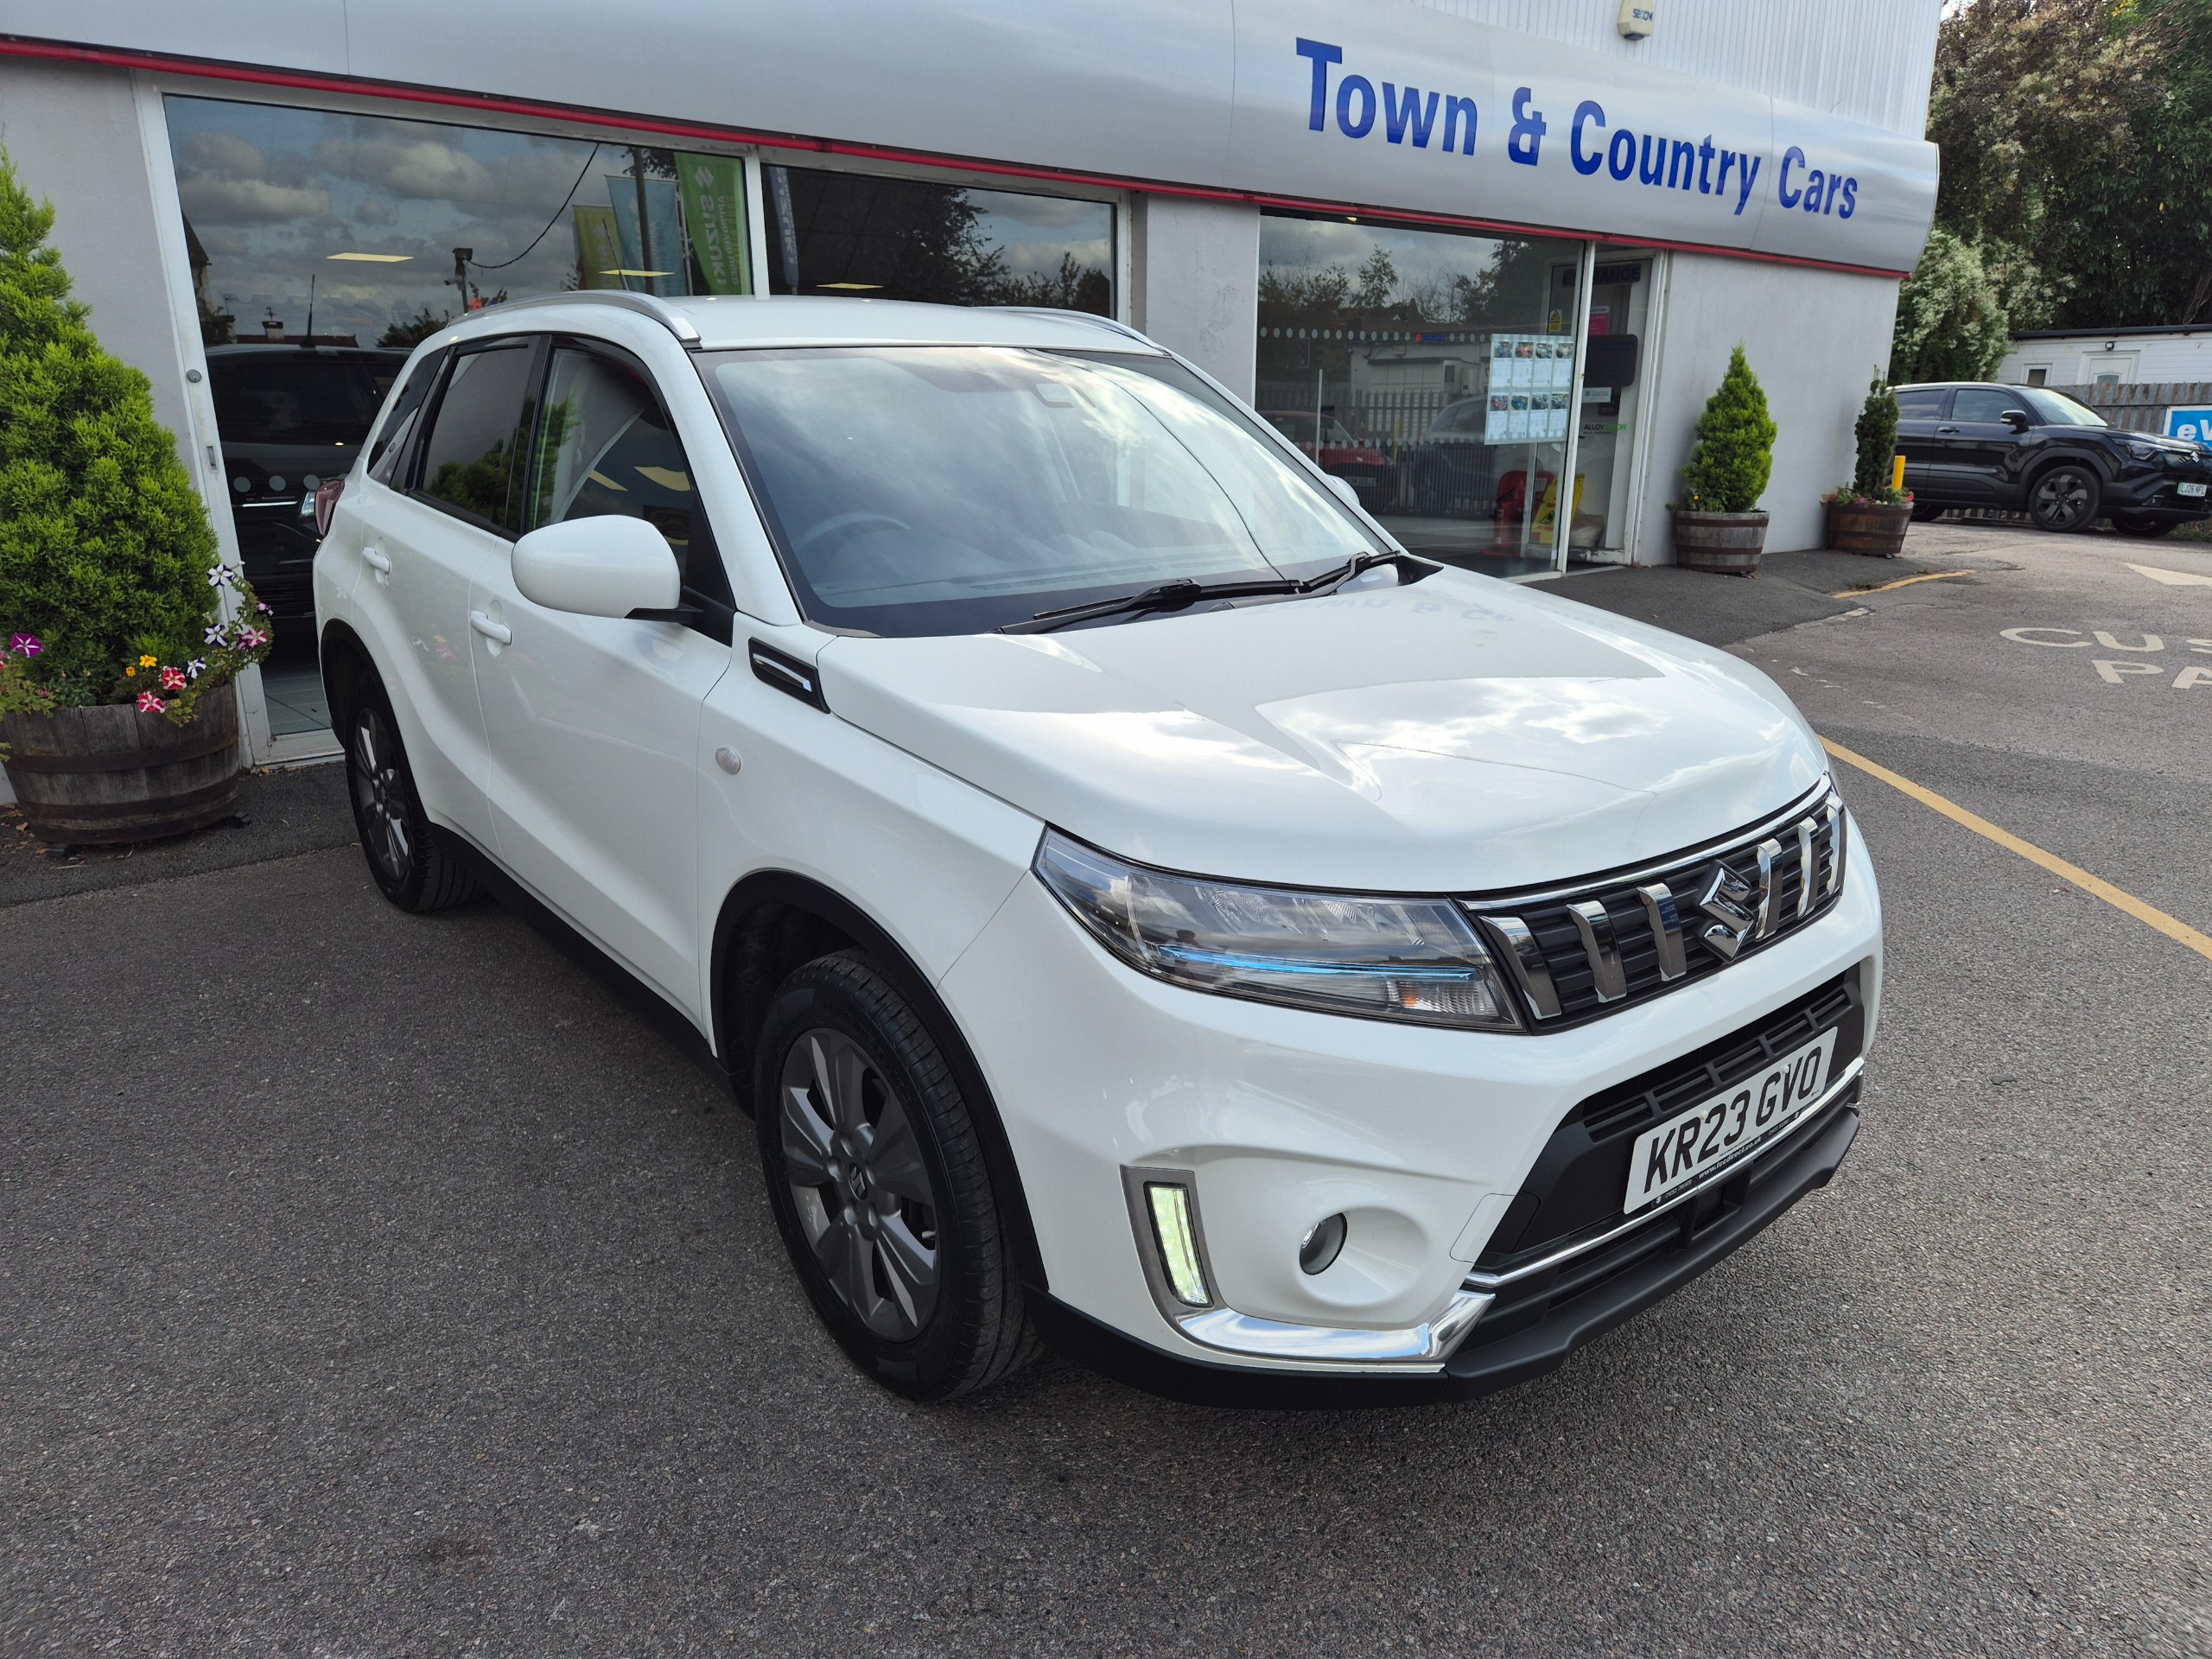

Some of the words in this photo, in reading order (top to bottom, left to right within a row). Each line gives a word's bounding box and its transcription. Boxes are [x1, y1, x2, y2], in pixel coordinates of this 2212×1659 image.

[1296, 37, 1477, 156] Town
[1508, 87, 1547, 166] &
[1570, 100, 1761, 215] Country
[1778, 146, 1858, 219] Cars
[1643, 1090, 1751, 1194] KR23
[1755, 1046, 1821, 1127] GVO
